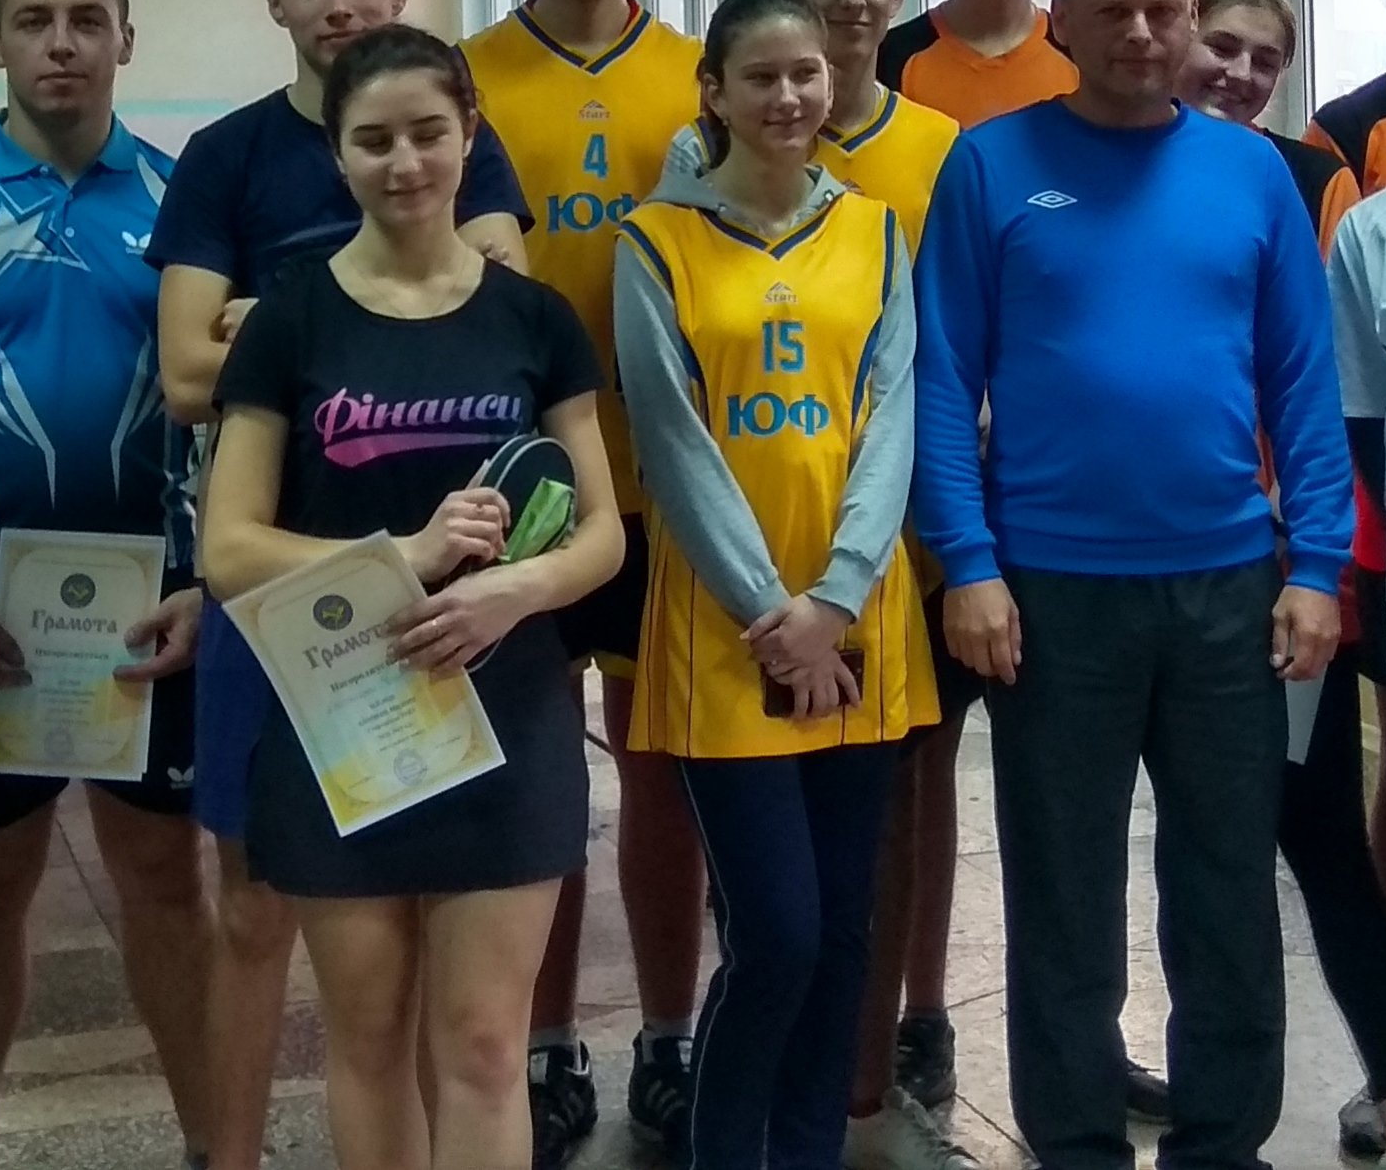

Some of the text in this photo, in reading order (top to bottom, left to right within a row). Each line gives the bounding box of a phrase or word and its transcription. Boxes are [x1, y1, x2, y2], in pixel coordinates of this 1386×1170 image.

[583, 133, 608, 180] 4
[765, 292, 797, 303] Start
[762, 320, 806, 374] 15
[314, 387, 522, 445] Фінанси
[727, 392, 831, 437] ЮФ
[31, 609, 118, 635] Грамота
[303, 623, 390, 670] Грамот
